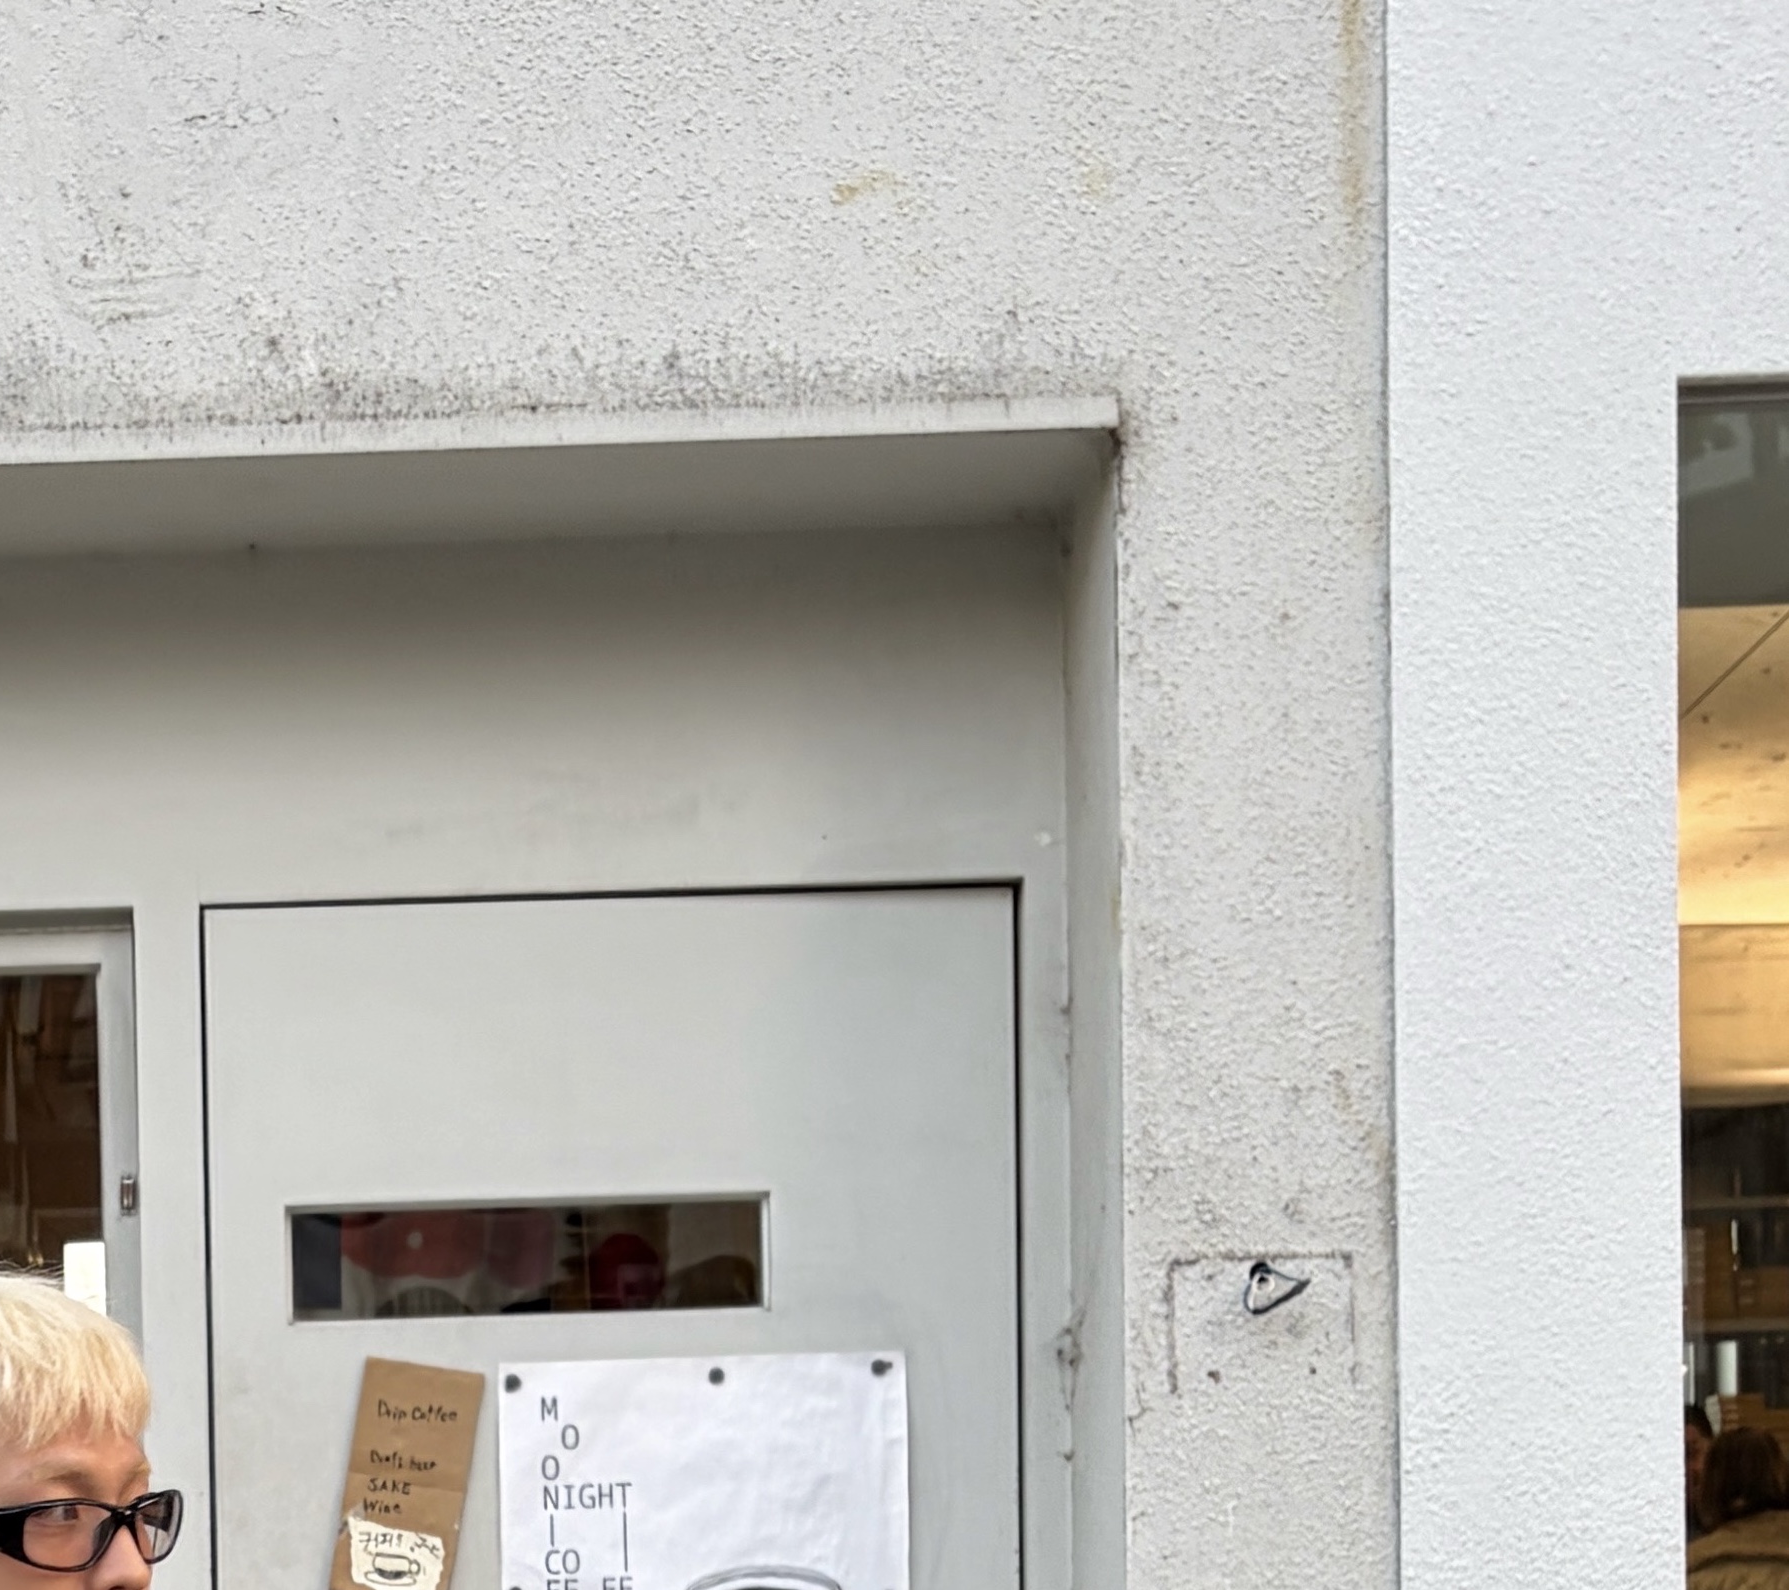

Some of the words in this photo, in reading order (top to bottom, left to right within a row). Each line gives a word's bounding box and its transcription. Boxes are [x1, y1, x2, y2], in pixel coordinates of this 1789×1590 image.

[540, 1396, 559, 1421] M
[367, 1477, 412, 1496] SAKE
[543, 1482, 632, 1511] NIGHT
[363, 1497, 403, 1515] Wine
[544, 1549, 581, 1575] CO
